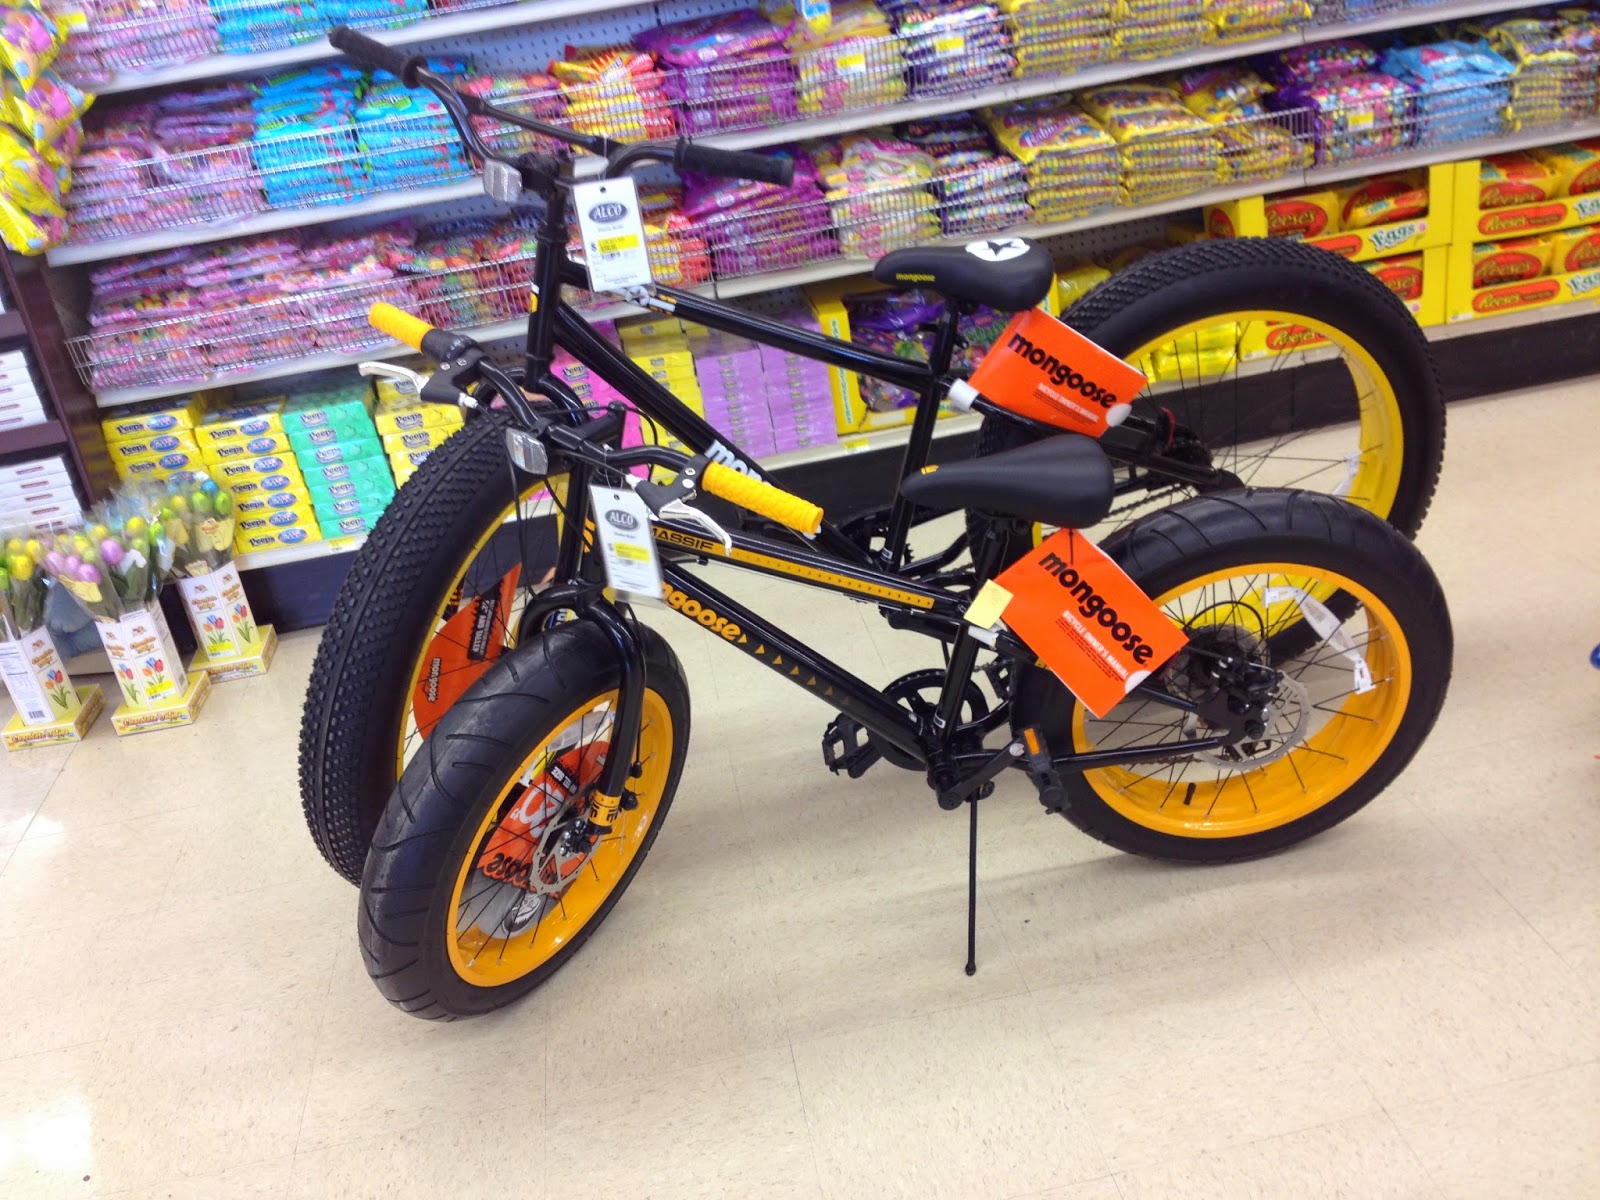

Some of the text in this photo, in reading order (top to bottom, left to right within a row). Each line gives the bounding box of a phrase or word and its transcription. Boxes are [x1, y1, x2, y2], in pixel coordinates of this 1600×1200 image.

[594, 203, 623, 220] ALCO
[1370, 224, 1416, 249] Eggs
[895, 273, 936, 282] mongoose
[1008, 332, 1117, 408] mongoose
[572, 383, 592, 393] eeps
[300, 410, 328, 424] Peeps
[395, 413, 423, 424] Peeps
[117, 422, 145, 434] Peeps
[210, 427, 237, 440] Peeps
[308, 427, 336, 441] Peeps
[402, 431, 429, 442] Peeps
[120, 444, 147, 456] Peeps
[217, 446, 244, 458] Peeps
[129, 461, 157, 473] Peeps
[224, 464, 251, 476] Peeps
[322, 463, 350, 477] Peeps
[231, 482, 258, 493] Peeps
[328, 482, 356, 495] Peeps
[239, 500, 265, 512] Peeps
[240, 518, 266, 530] Peeps
[339, 517, 367, 530] Peeps
[609, 512, 634, 526] ALCO
[249, 535, 276, 547] Peeps
[1038, 552, 1154, 665] mongoose
[1062, 609, 1129, 679] BICYCLE OWNER'S MANUAL
[428, 658, 441, 702] mongoose
